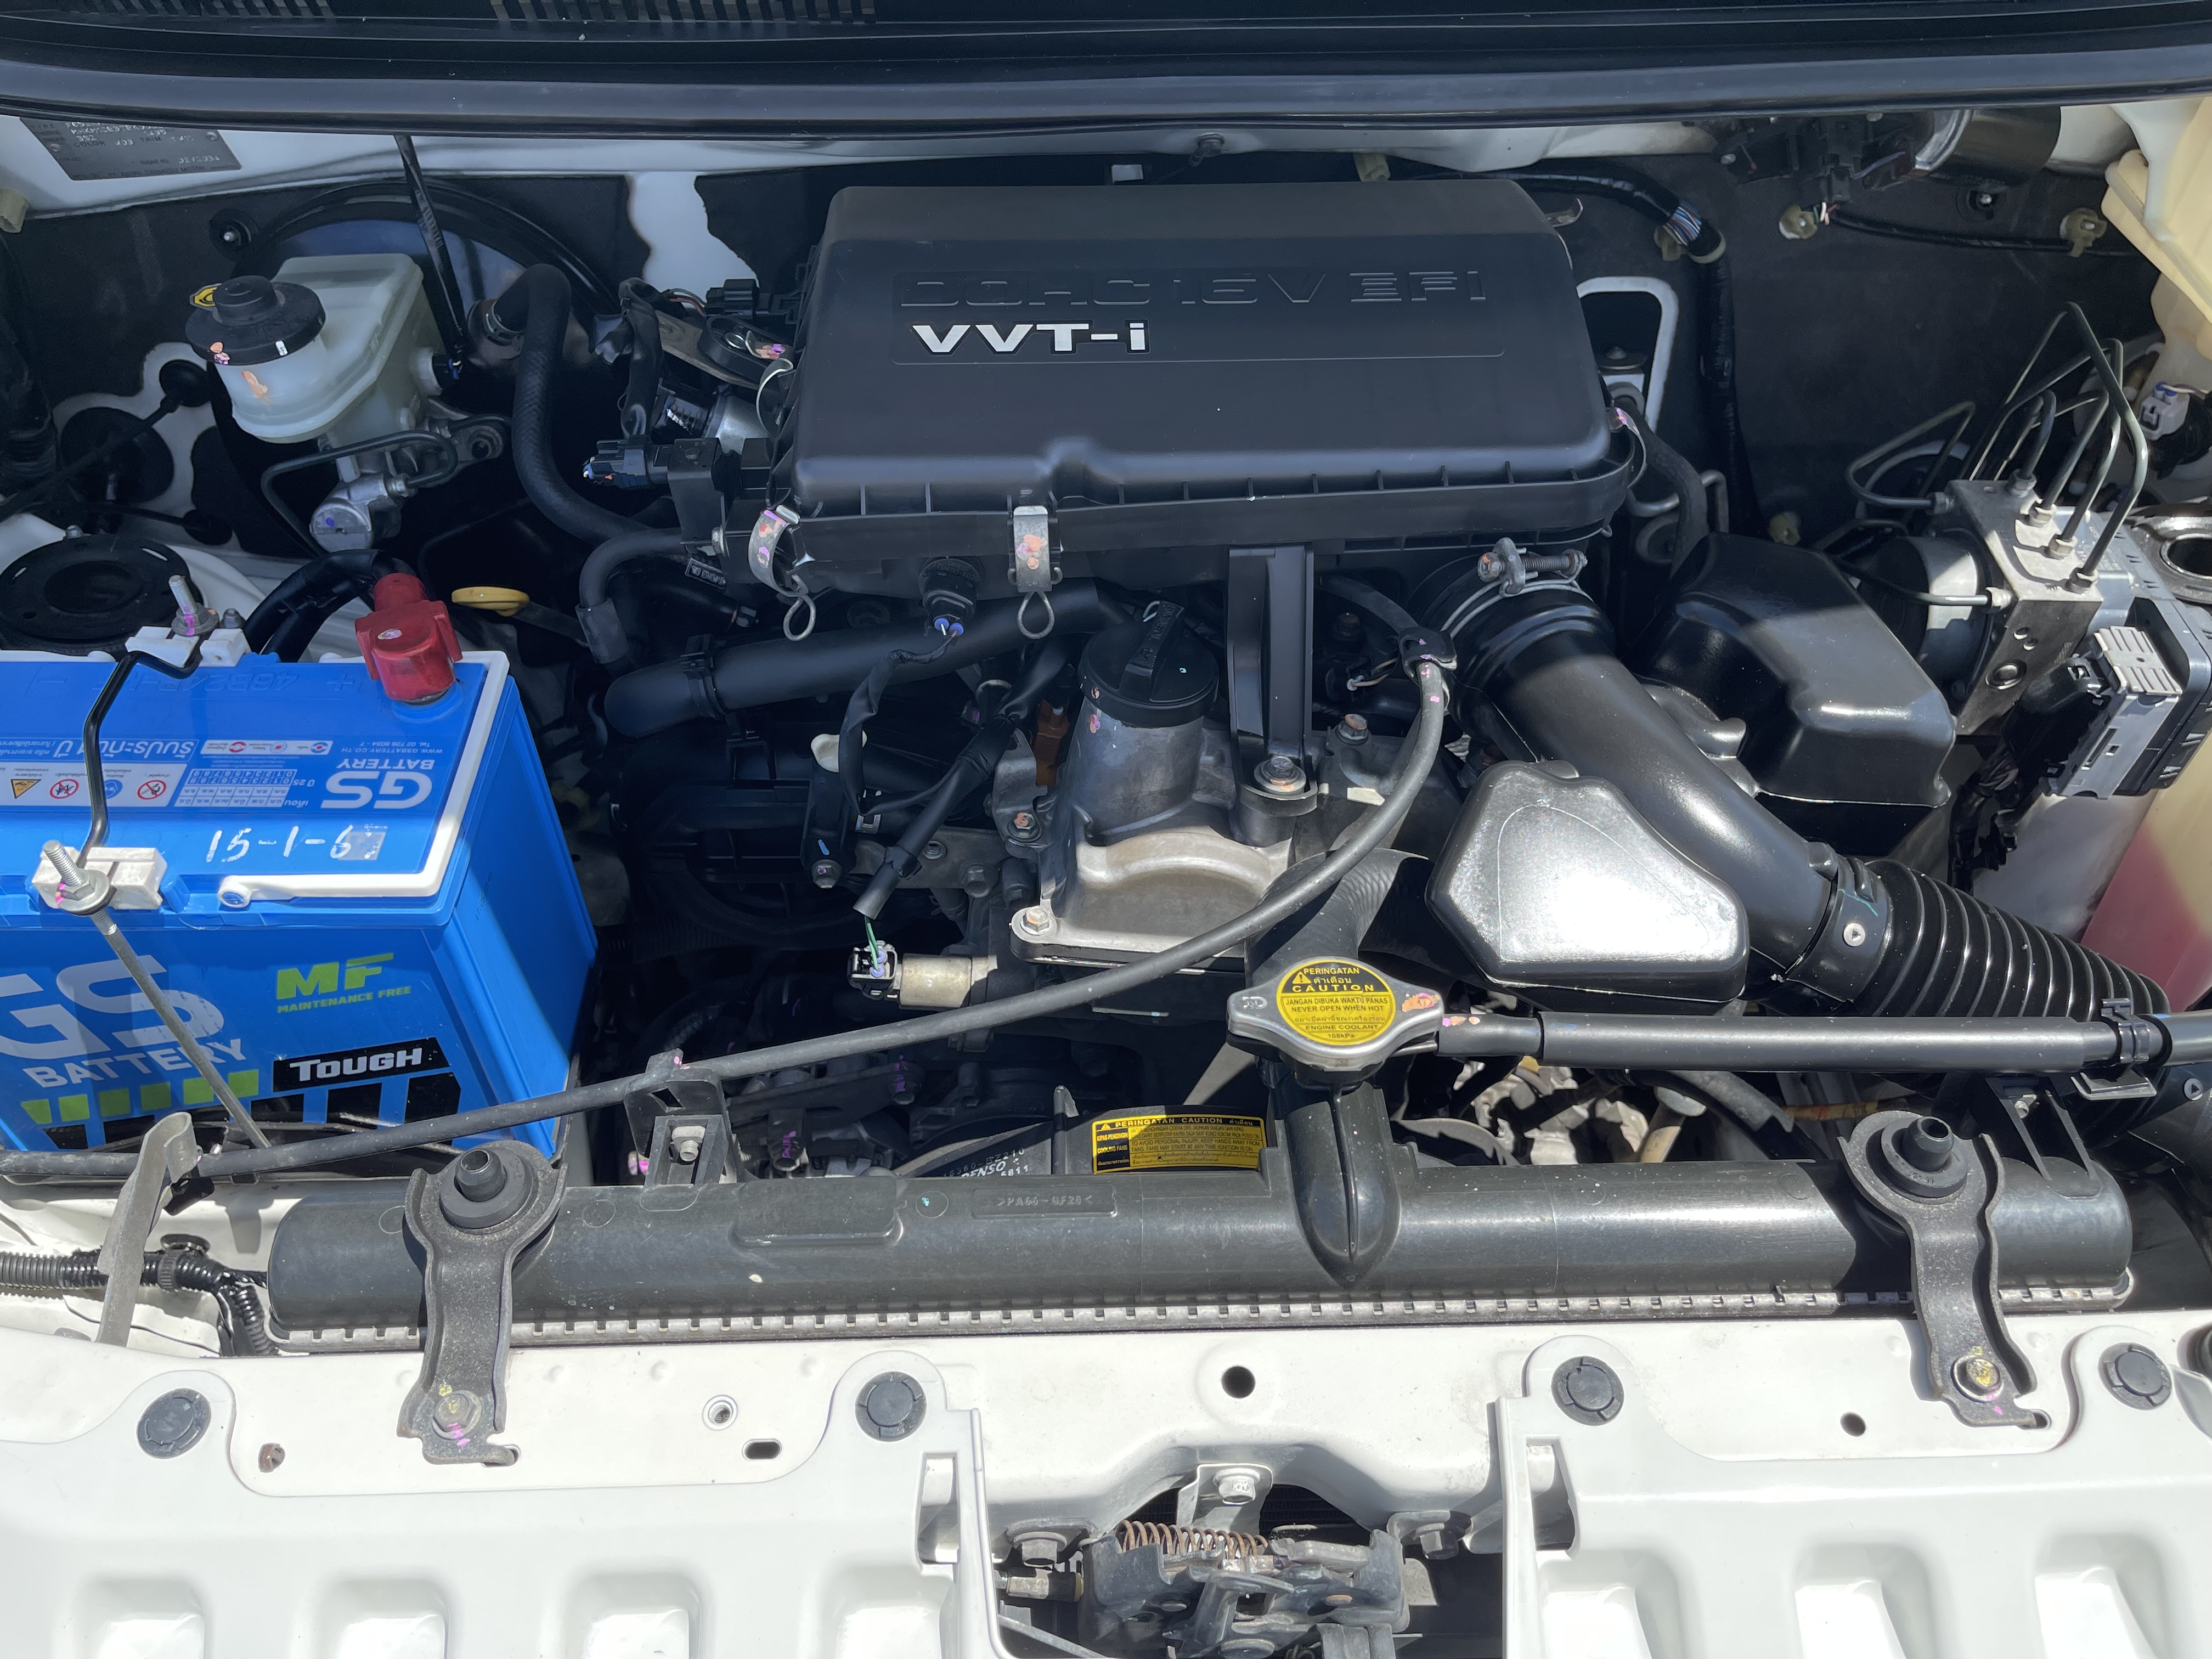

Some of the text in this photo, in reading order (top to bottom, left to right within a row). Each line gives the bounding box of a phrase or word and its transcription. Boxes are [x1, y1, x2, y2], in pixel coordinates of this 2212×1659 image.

[1349, 270, 1488, 303] EFI
[910, 320, 1149, 354] VVT-i
[335, 758, 435, 770] BATTERY
[320, 770, 432, 809] GS
[276, 952, 395, 1001] MF
[1292, 984, 1374, 992] CAUTION
[277, 985, 412, 1014] MAINTENANCE FREE
[1115, 1118, 1175, 1127] PERINGATAN
